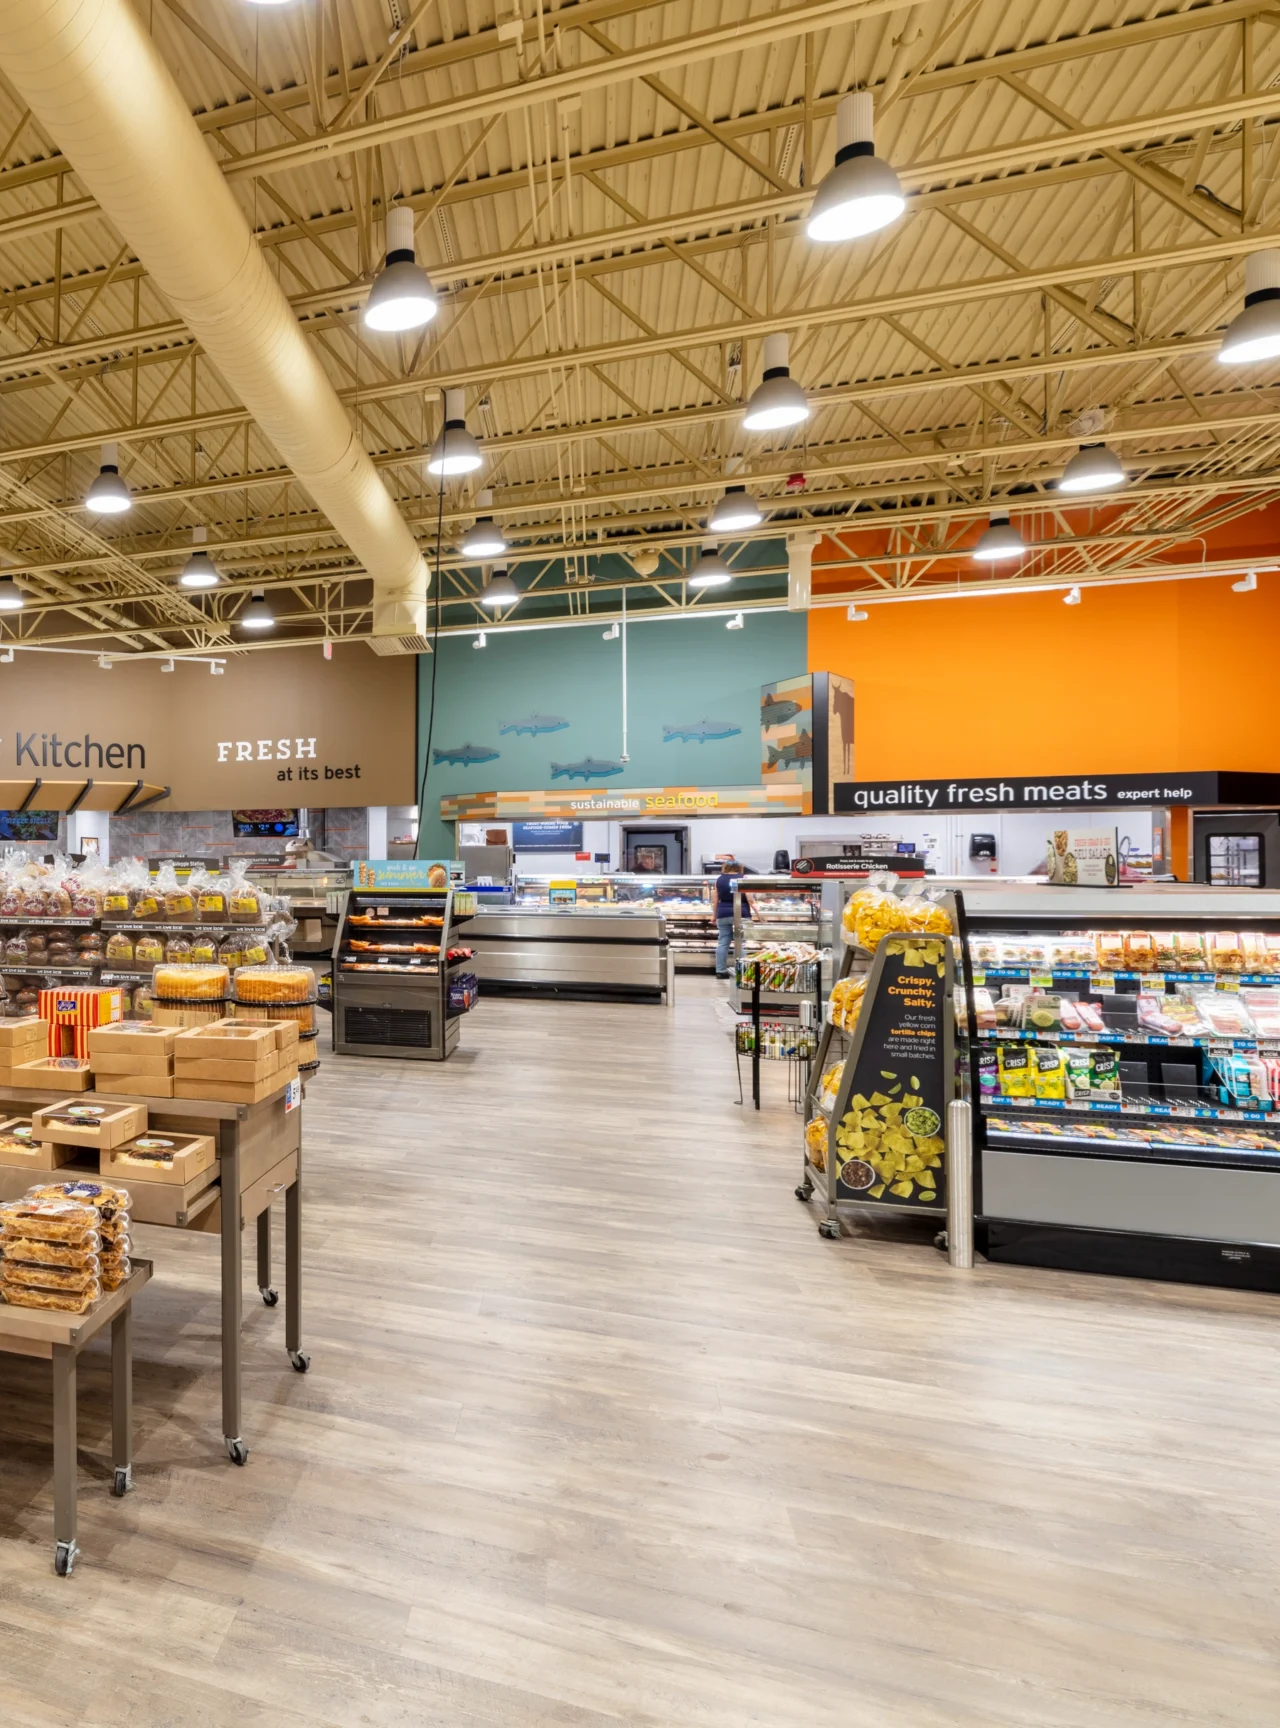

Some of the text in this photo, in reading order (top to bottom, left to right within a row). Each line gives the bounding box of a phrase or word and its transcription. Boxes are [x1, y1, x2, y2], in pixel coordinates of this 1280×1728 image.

[16, 732, 146, 769] Kitchen
[217, 738, 317, 762] FRESH
[276, 764, 361, 781] at its best
[854, 780, 1193, 808] quality fresh meats expert help
[570, 792, 719, 810] sustainable seafood
[897, 976, 936, 986] Crispy.
[888, 986, 936, 997] Crunchy.
[903, 998, 936, 1008] Salty.
[917, 1029, 936, 1037] chips
[920, 1037, 936, 1045] right
[929, 1044, 936, 1052] in
[908, 1052, 936, 1060] batches.
[979, 1055, 995, 1065] RISP
[1005, 1057, 1027, 1068] CRISP
[1040, 1060, 1059, 1069] CRISP
[1095, 1061, 1115, 1072] CRISP
